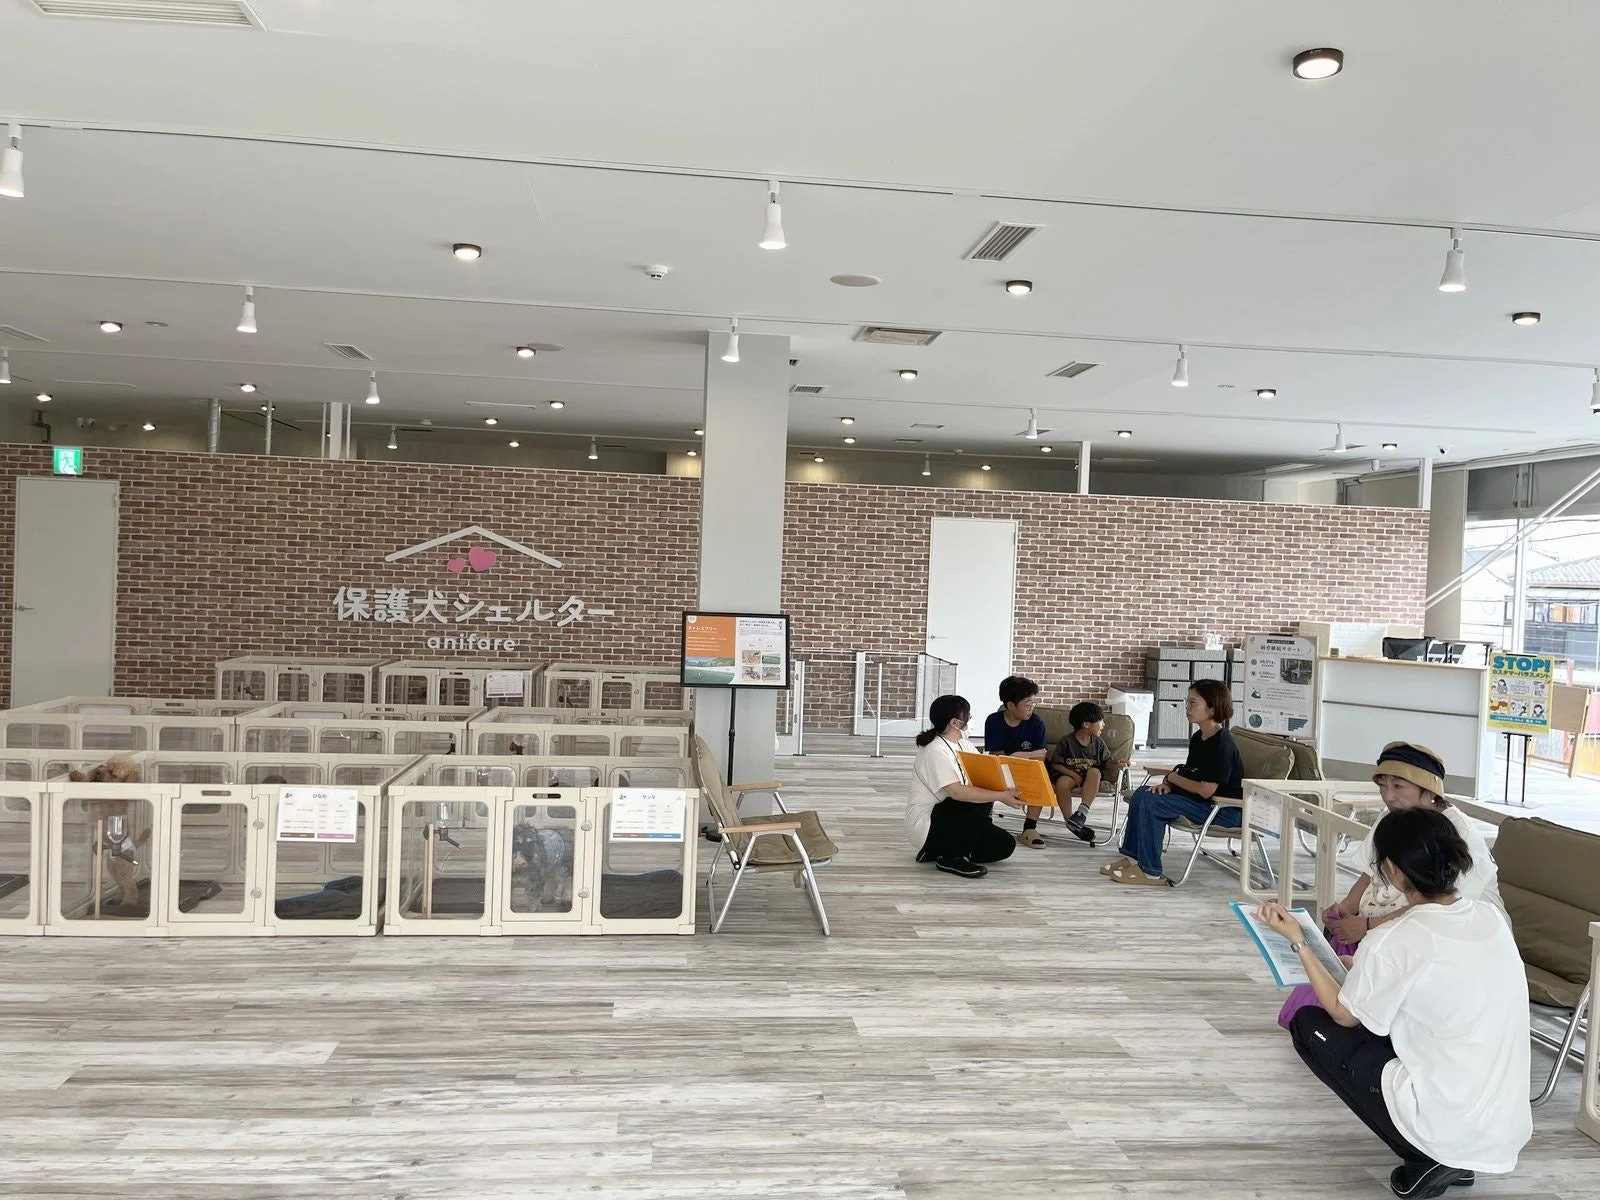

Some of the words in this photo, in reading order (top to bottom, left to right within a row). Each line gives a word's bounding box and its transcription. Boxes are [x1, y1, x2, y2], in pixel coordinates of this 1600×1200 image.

[332, 586, 615, 628] 保護犬シェルター
[427, 633, 517, 652] anifare
[1493, 655, 1551, 673] STOP!
